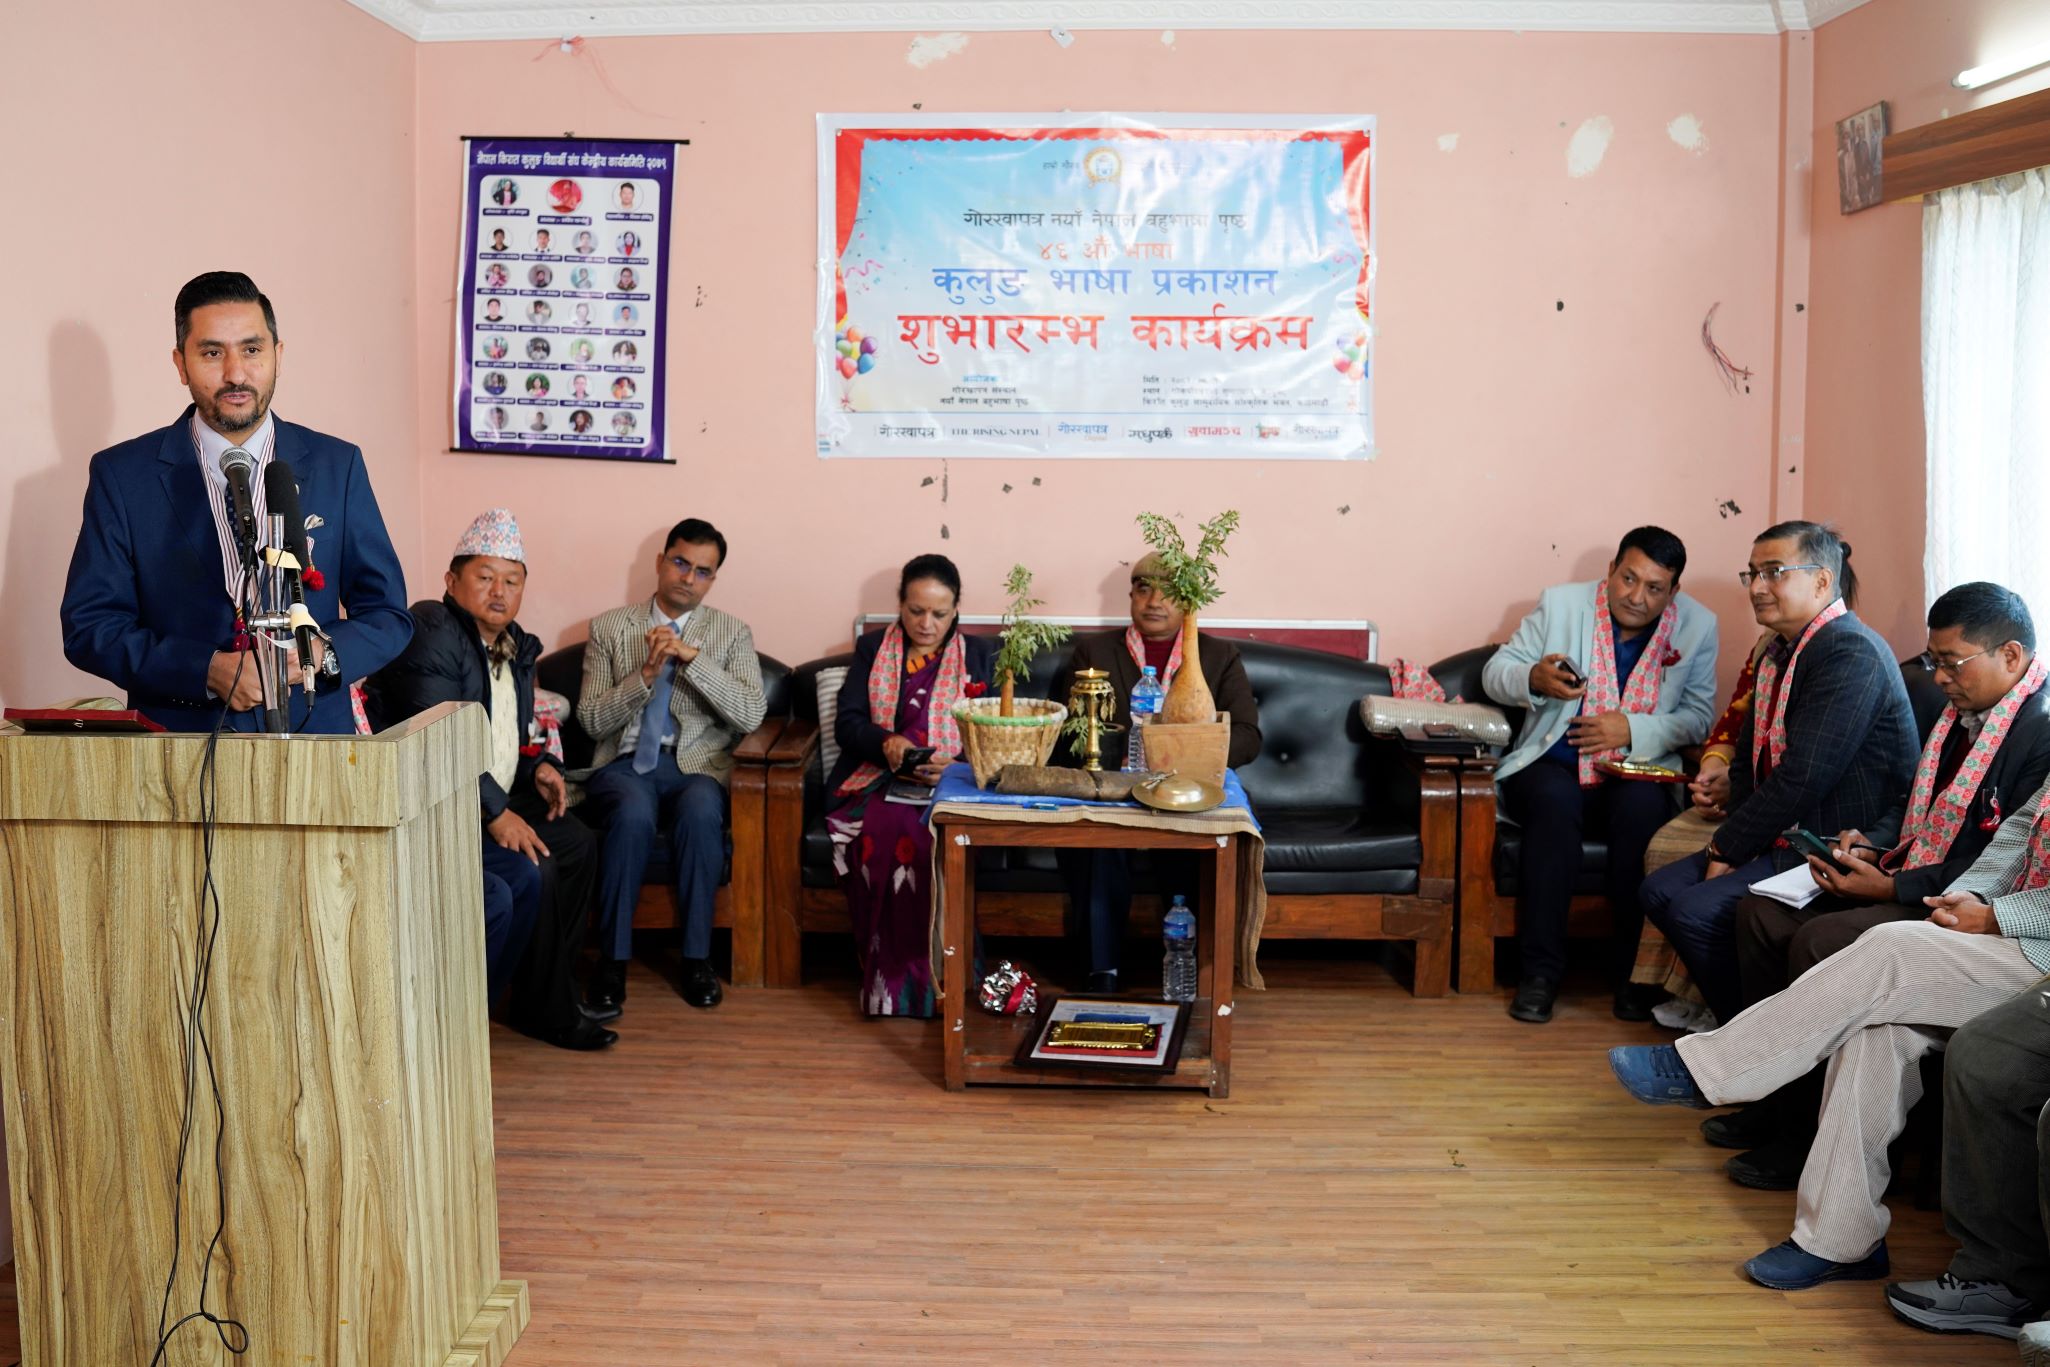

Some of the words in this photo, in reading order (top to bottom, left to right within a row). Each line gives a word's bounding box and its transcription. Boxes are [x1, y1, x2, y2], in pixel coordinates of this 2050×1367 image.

[963, 209, 1045, 228] गोरखापत्र
[1051, 209, 1082, 228] नयाँ
[1092, 209, 1137, 228] नेपाल
[1038, 242, 1069, 261] ४६
[1125, 242, 1175, 261] भाषा
[931, 268, 1028, 305] कुलुङ
[1050, 269, 1132, 297] भाषा
[1152, 269, 1279, 297] प्रकाशन
[897, 315, 1105, 365] शुभारम्भ
[1131, 303, 1314, 352] कार्यक्रम
[880, 424, 936, 438] गोरखापत्र
[1058, 422, 1109, 434] गोरखापत्र
